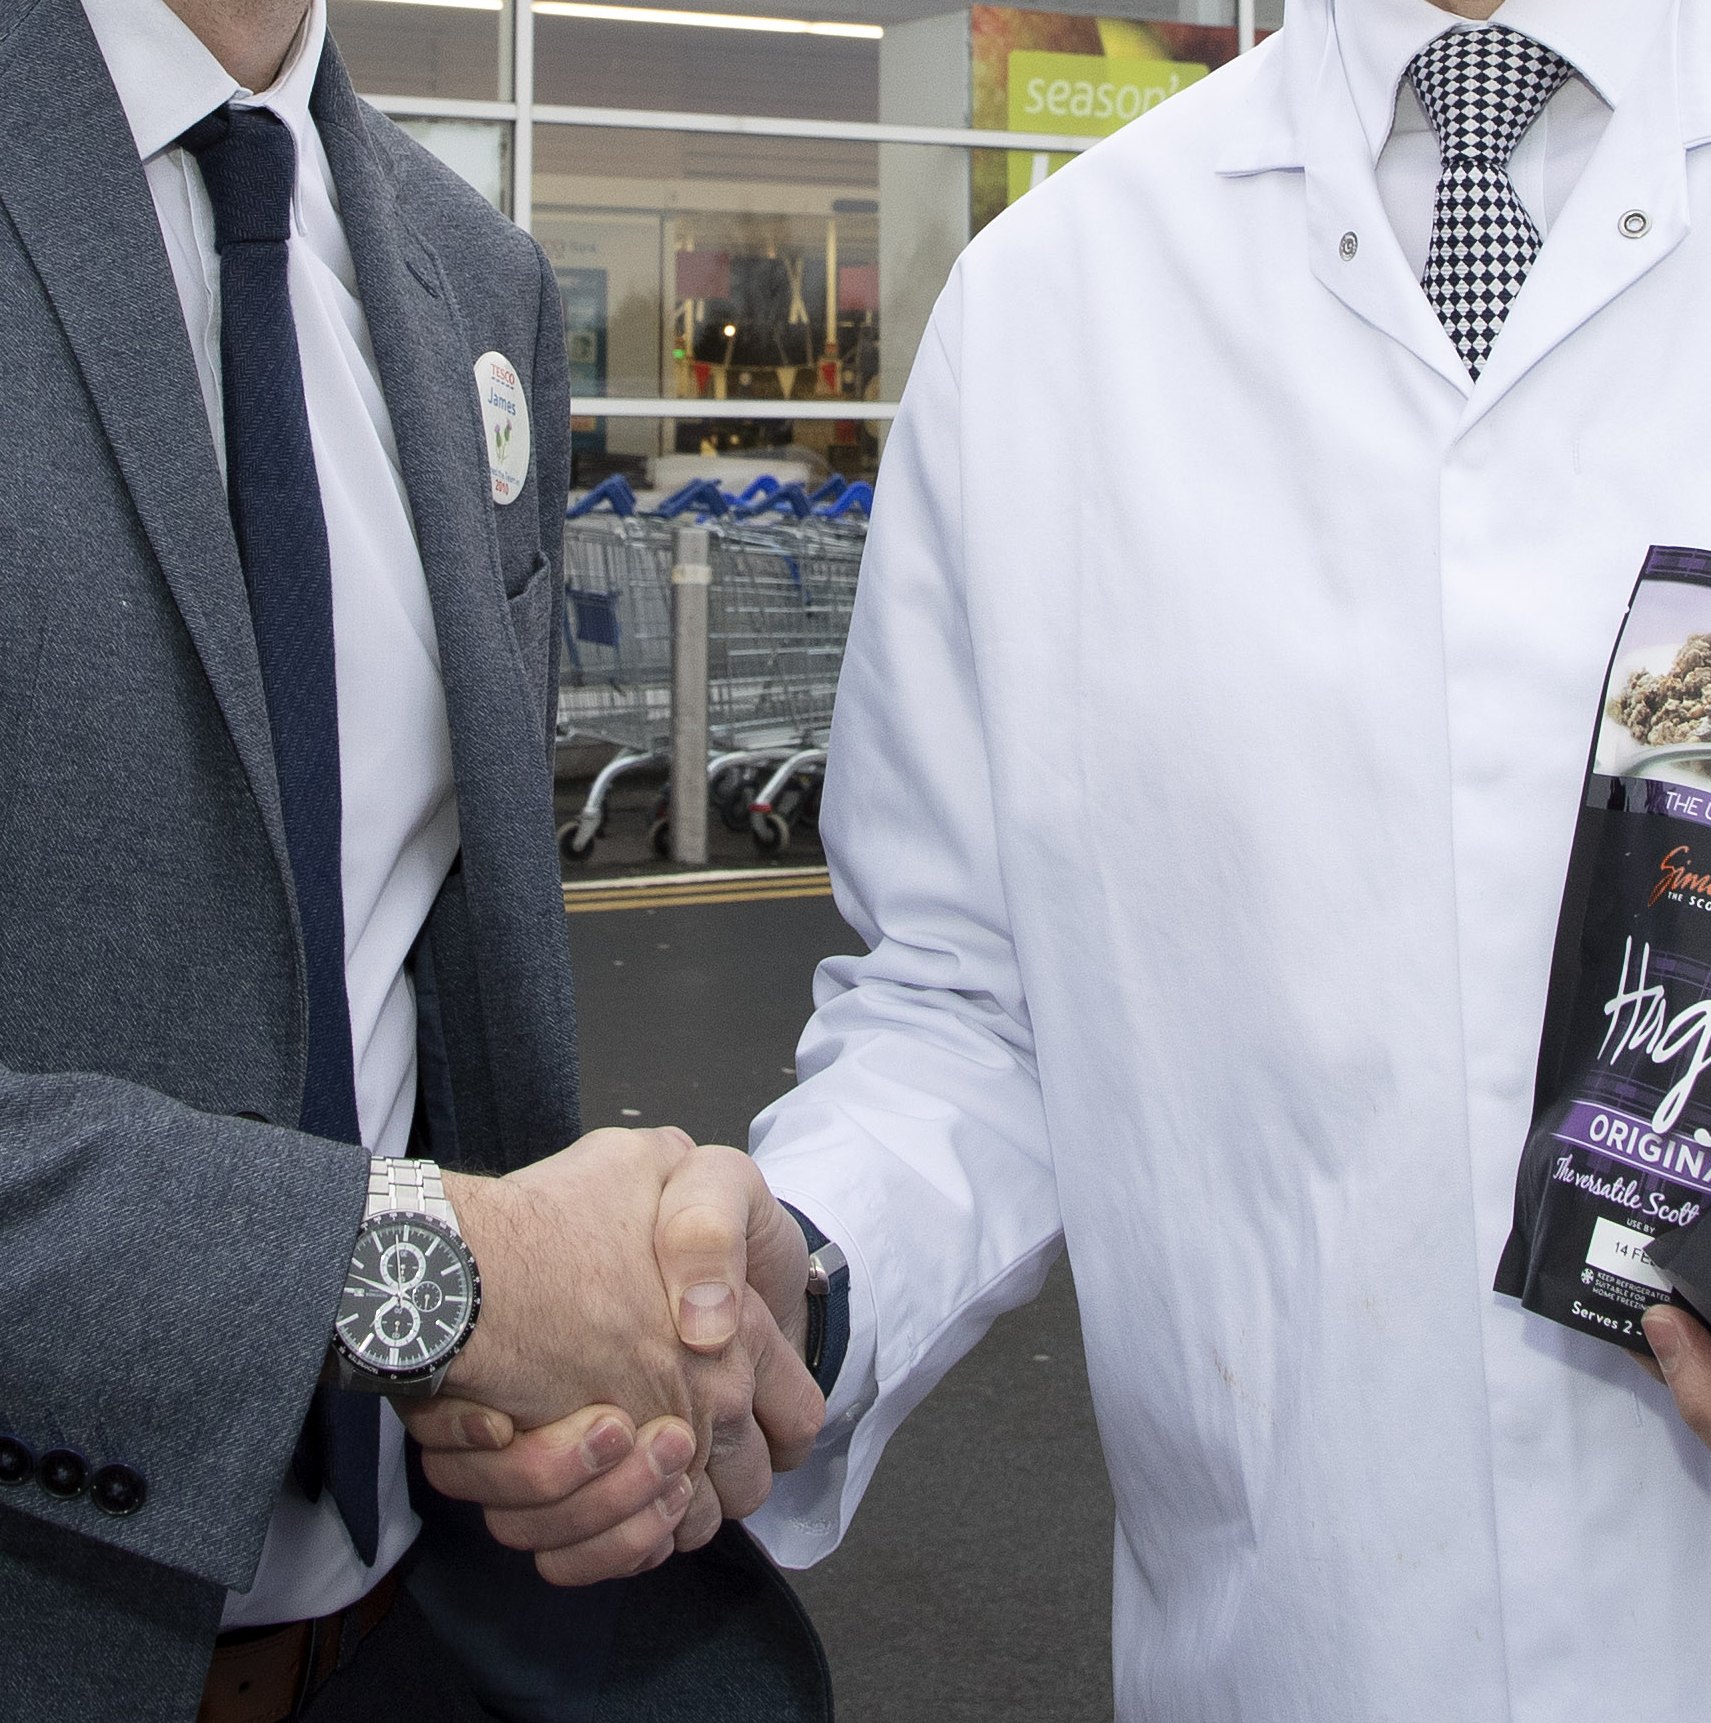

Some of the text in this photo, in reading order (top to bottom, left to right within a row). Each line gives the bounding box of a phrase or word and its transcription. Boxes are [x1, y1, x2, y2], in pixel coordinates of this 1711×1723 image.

[491, 363, 515, 386] TESCO
[488, 387, 516, 416] James
[1665, 790, 1703, 817] THE
[1667, 891, 1684, 902] THE
[1553, 1153, 1701, 1226] The versatile Scott
[1626, 1218, 1656, 1234] USE BY
[1615, 1241, 1656, 1267] 14 FE
[1597, 1271, 1616, 1283] KEEP
[1592, 1287, 1615, 1301] HOME
[1595, 1278, 1646, 1302] SUITABLE FOR
[1572, 1300, 1618, 1330] Serves
[1622, 1320, 1633, 1334] 2
